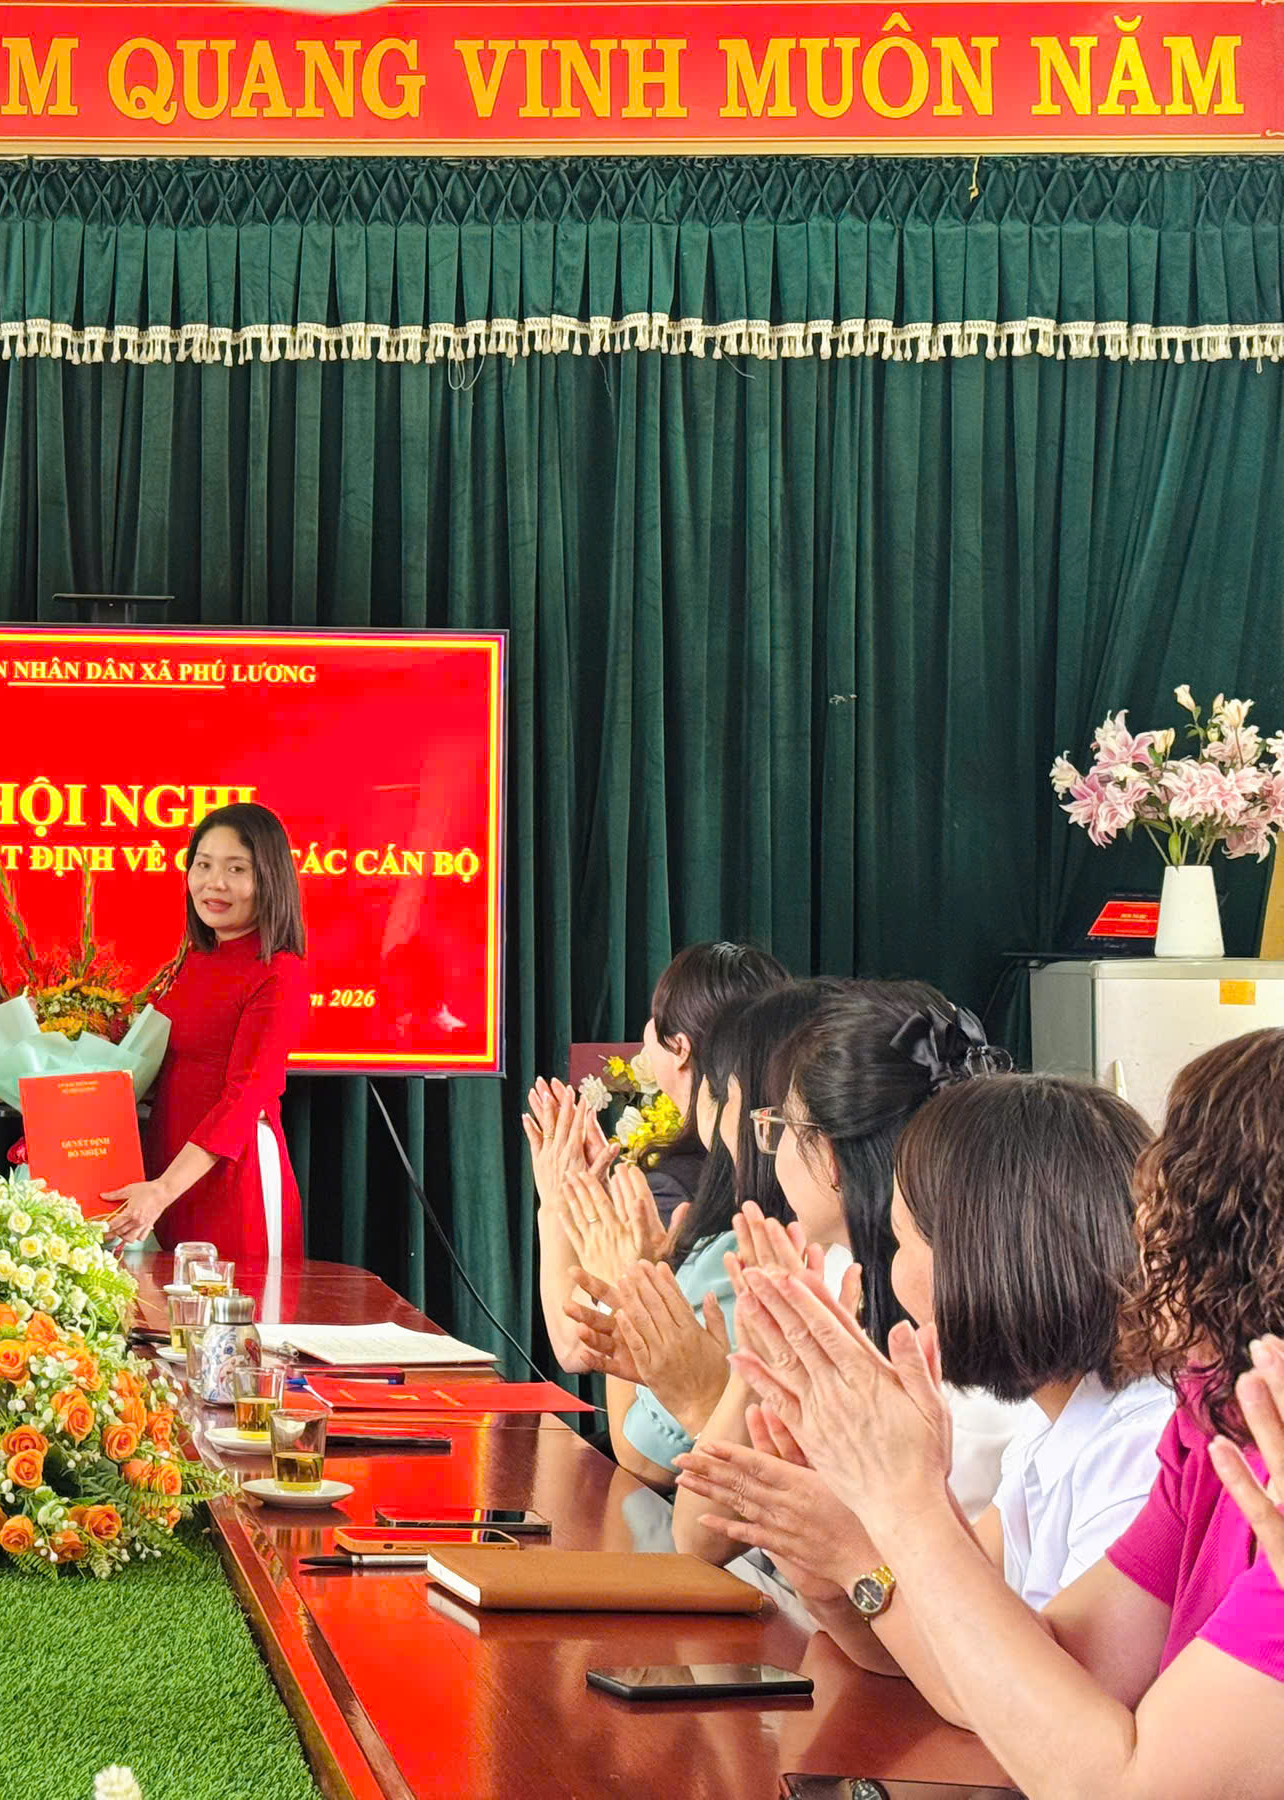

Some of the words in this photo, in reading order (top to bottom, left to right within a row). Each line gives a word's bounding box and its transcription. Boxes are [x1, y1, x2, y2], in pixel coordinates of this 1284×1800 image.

[107, 38, 427, 125] QUANG
[454, 39, 689, 118] VINH
[718, 12, 999, 119] MUÔN
[1030, 16, 1246, 116] NĂM
[14, 656, 82, 680] NHÂN
[86, 657, 135, 680] DÂN
[140, 659, 173, 681] XÃ
[179, 659, 227, 682] PHÚ
[232, 661, 318, 683] LƯƠNG
[29, 846, 116, 877] ĐỊNH
[122, 840, 167, 871] VỀ
[355, 843, 426, 876] CÁN
[432, 848, 480, 883] BỘ
[329, 988, 377, 1008] 2026
